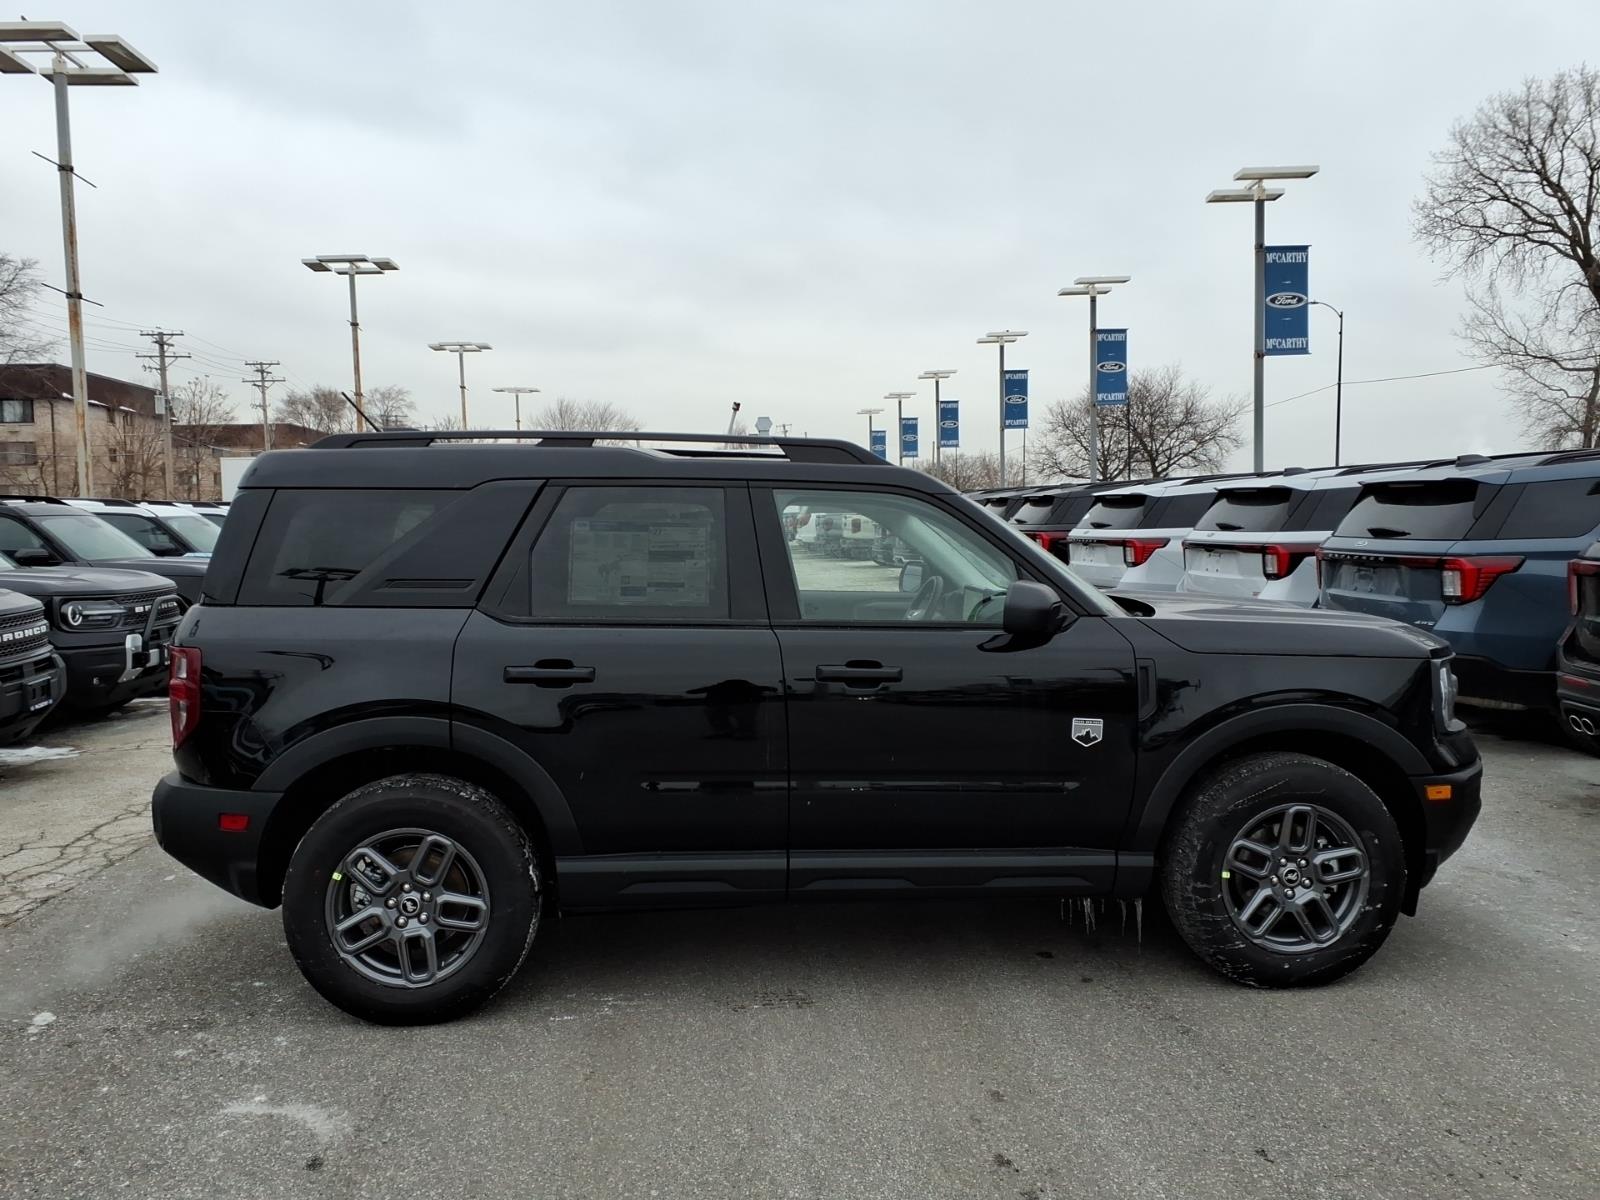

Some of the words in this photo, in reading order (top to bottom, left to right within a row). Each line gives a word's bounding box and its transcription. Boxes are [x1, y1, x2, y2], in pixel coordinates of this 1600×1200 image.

[1266, 252, 1308, 263] McCARTHY
[1274, 295, 1298, 305] Ford
[1266, 337, 1308, 349] McCARTHY
[0, 625, 47, 643] RONCO
